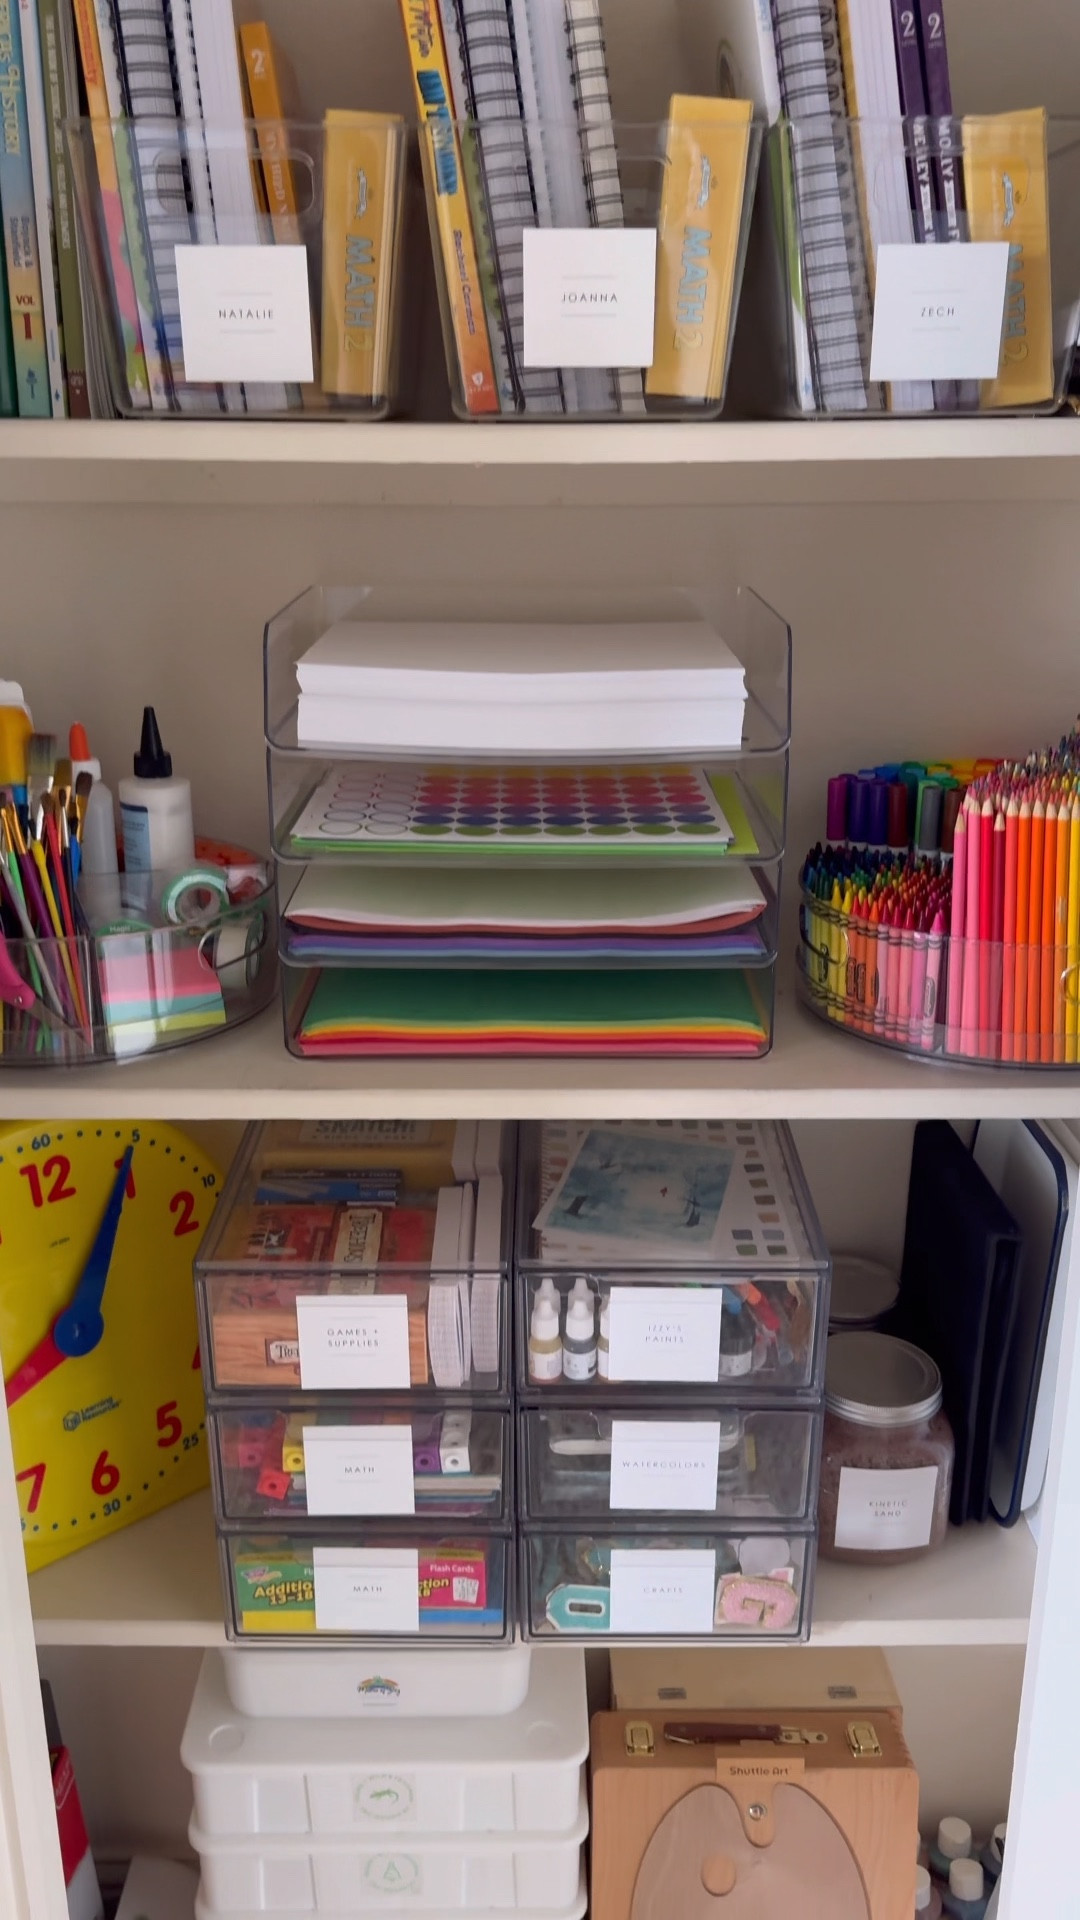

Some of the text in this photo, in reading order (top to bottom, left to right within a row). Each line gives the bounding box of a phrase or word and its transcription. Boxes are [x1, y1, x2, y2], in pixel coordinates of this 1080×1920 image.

[900, 10, 915, 36] 2
[928, 13, 942, 38] 2
[250, 48, 266, 74] 2
[345, 235, 375, 329] MATH
[673, 224, 712, 352] MATH 2
[16, 295, 36, 307] VOL
[558, 293, 618, 302] JOANNA
[218, 309, 275, 319] NATALIE
[920, 307, 955, 317] ZECH
[344, 335, 373, 353] 2
[31, 1133, 51, 1151] 60
[131, 1129, 140, 1143] 5
[19, 1155, 76, 1208] 12
[202, 1174, 216, 1188] 10
[169, 1191, 200, 1237] 2
[327, 1328, 368, 1336] GAMES
[645, 1335, 684, 1343] PAINTS
[328, 1339, 380, 1347] SUPPLIES
[156, 1400, 183, 1449] 5
[182, 1432, 199, 1451] 25
[344, 1466, 375, 1474] MATH
[622, 1460, 707, 1469] WATERCOLORS
[91, 1449, 120, 1496] 6
[16, 1462, 47, 1514] 7
[103, 1498, 121, 1517] 30
[868, 1500, 907, 1508] KINETIC
[430, 1564, 474, 1574] Flash Cards
[254, 1580, 314, 1599] Additio
[353, 1585, 383, 1593] MATH
[643, 1586, 684, 1595] CRAFTS
[729, 1766, 789, 1777] Shuttle Art
